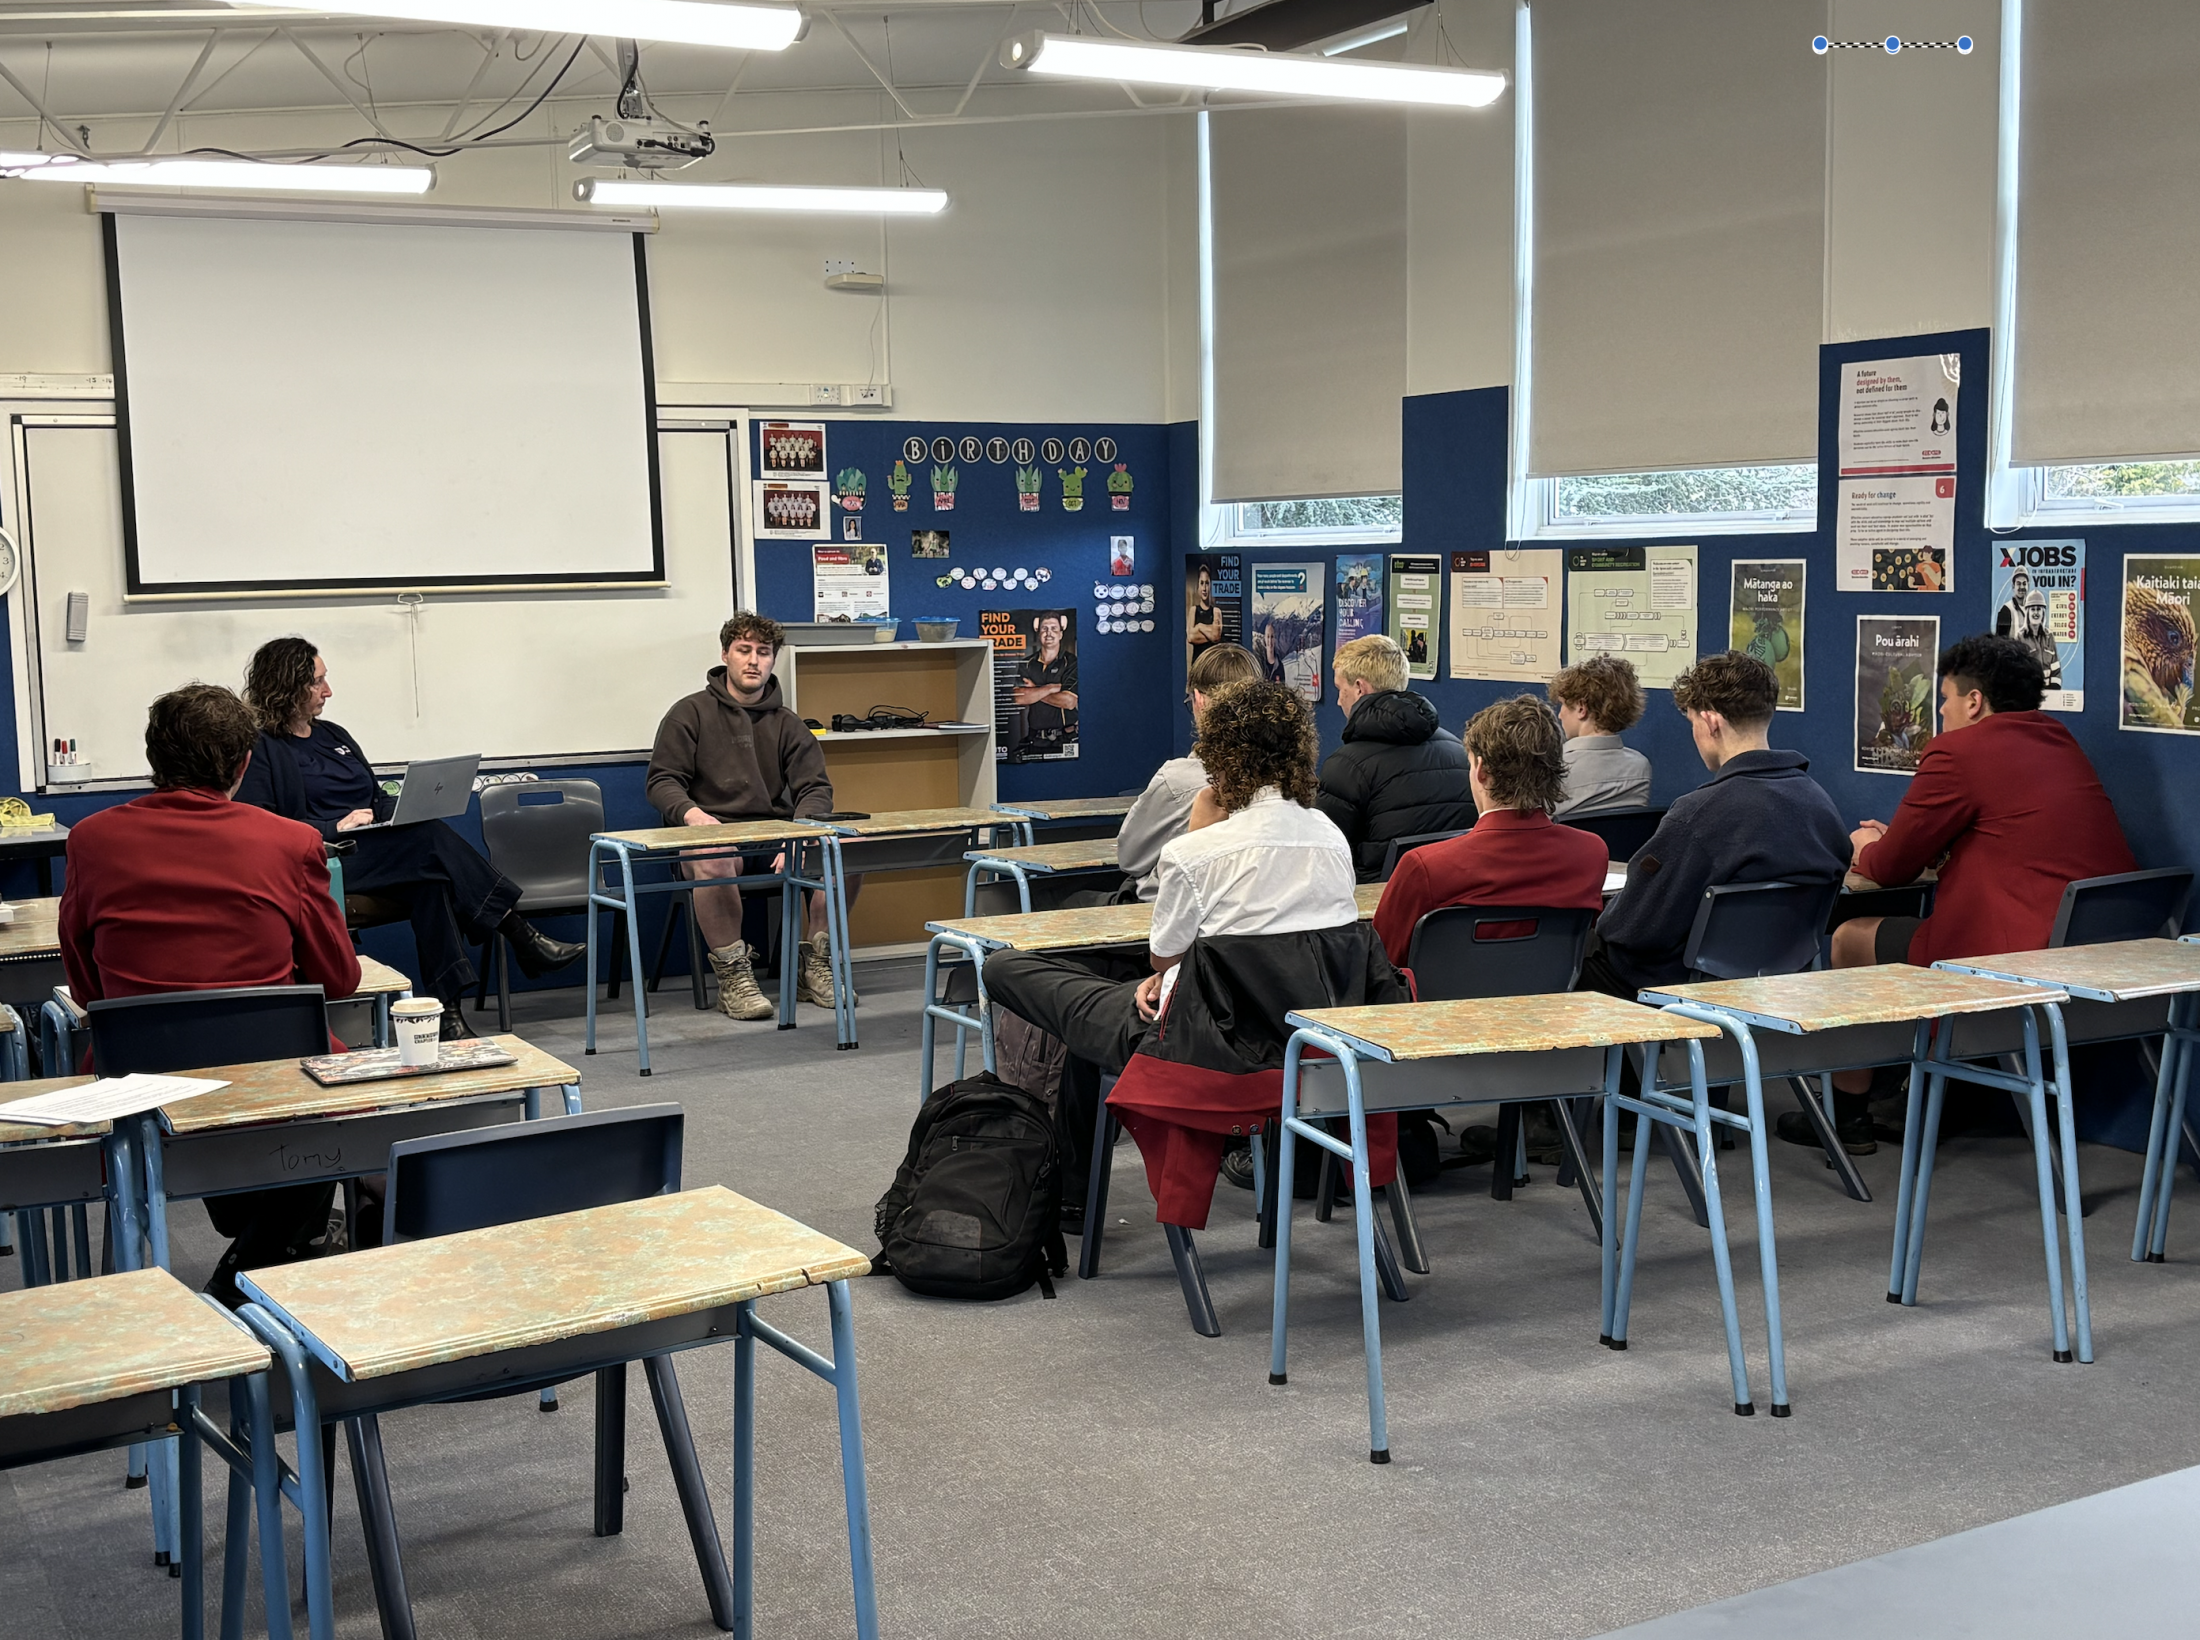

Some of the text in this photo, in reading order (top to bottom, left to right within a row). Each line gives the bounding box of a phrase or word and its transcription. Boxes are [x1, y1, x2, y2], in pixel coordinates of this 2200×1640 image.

[1857, 378, 1879, 386] designed
[1880, 377, 1886, 385] by
[1866, 385, 1884, 393] defined
[1885, 384, 1893, 392] for
[1939, 485, 1945, 494] 6
[1852, 491, 1896, 500] Ready for change
[1220, 556, 1240, 567] FIND
[1217, 569, 1240, 580] YOUR
[1743, 577, 1793, 592] Mātanga ao
[2032, 576, 2077, 587] YOU IN?
[2136, 575, 2180, 589] Kaitiaki
[1213, 583, 1240, 594] TRADE
[1757, 590, 1778, 602] haka
[2156, 591, 2190, 605] Māori
[1339, 598, 1367, 607] DISCOVER
[981, 613, 1011, 623] FIND
[1339, 618, 1364, 629] CALLING
[982, 624, 1016, 634] YOUR
[993, 637, 1023, 647] RADE
[1875, 634, 1920, 647] Pou ārahi
